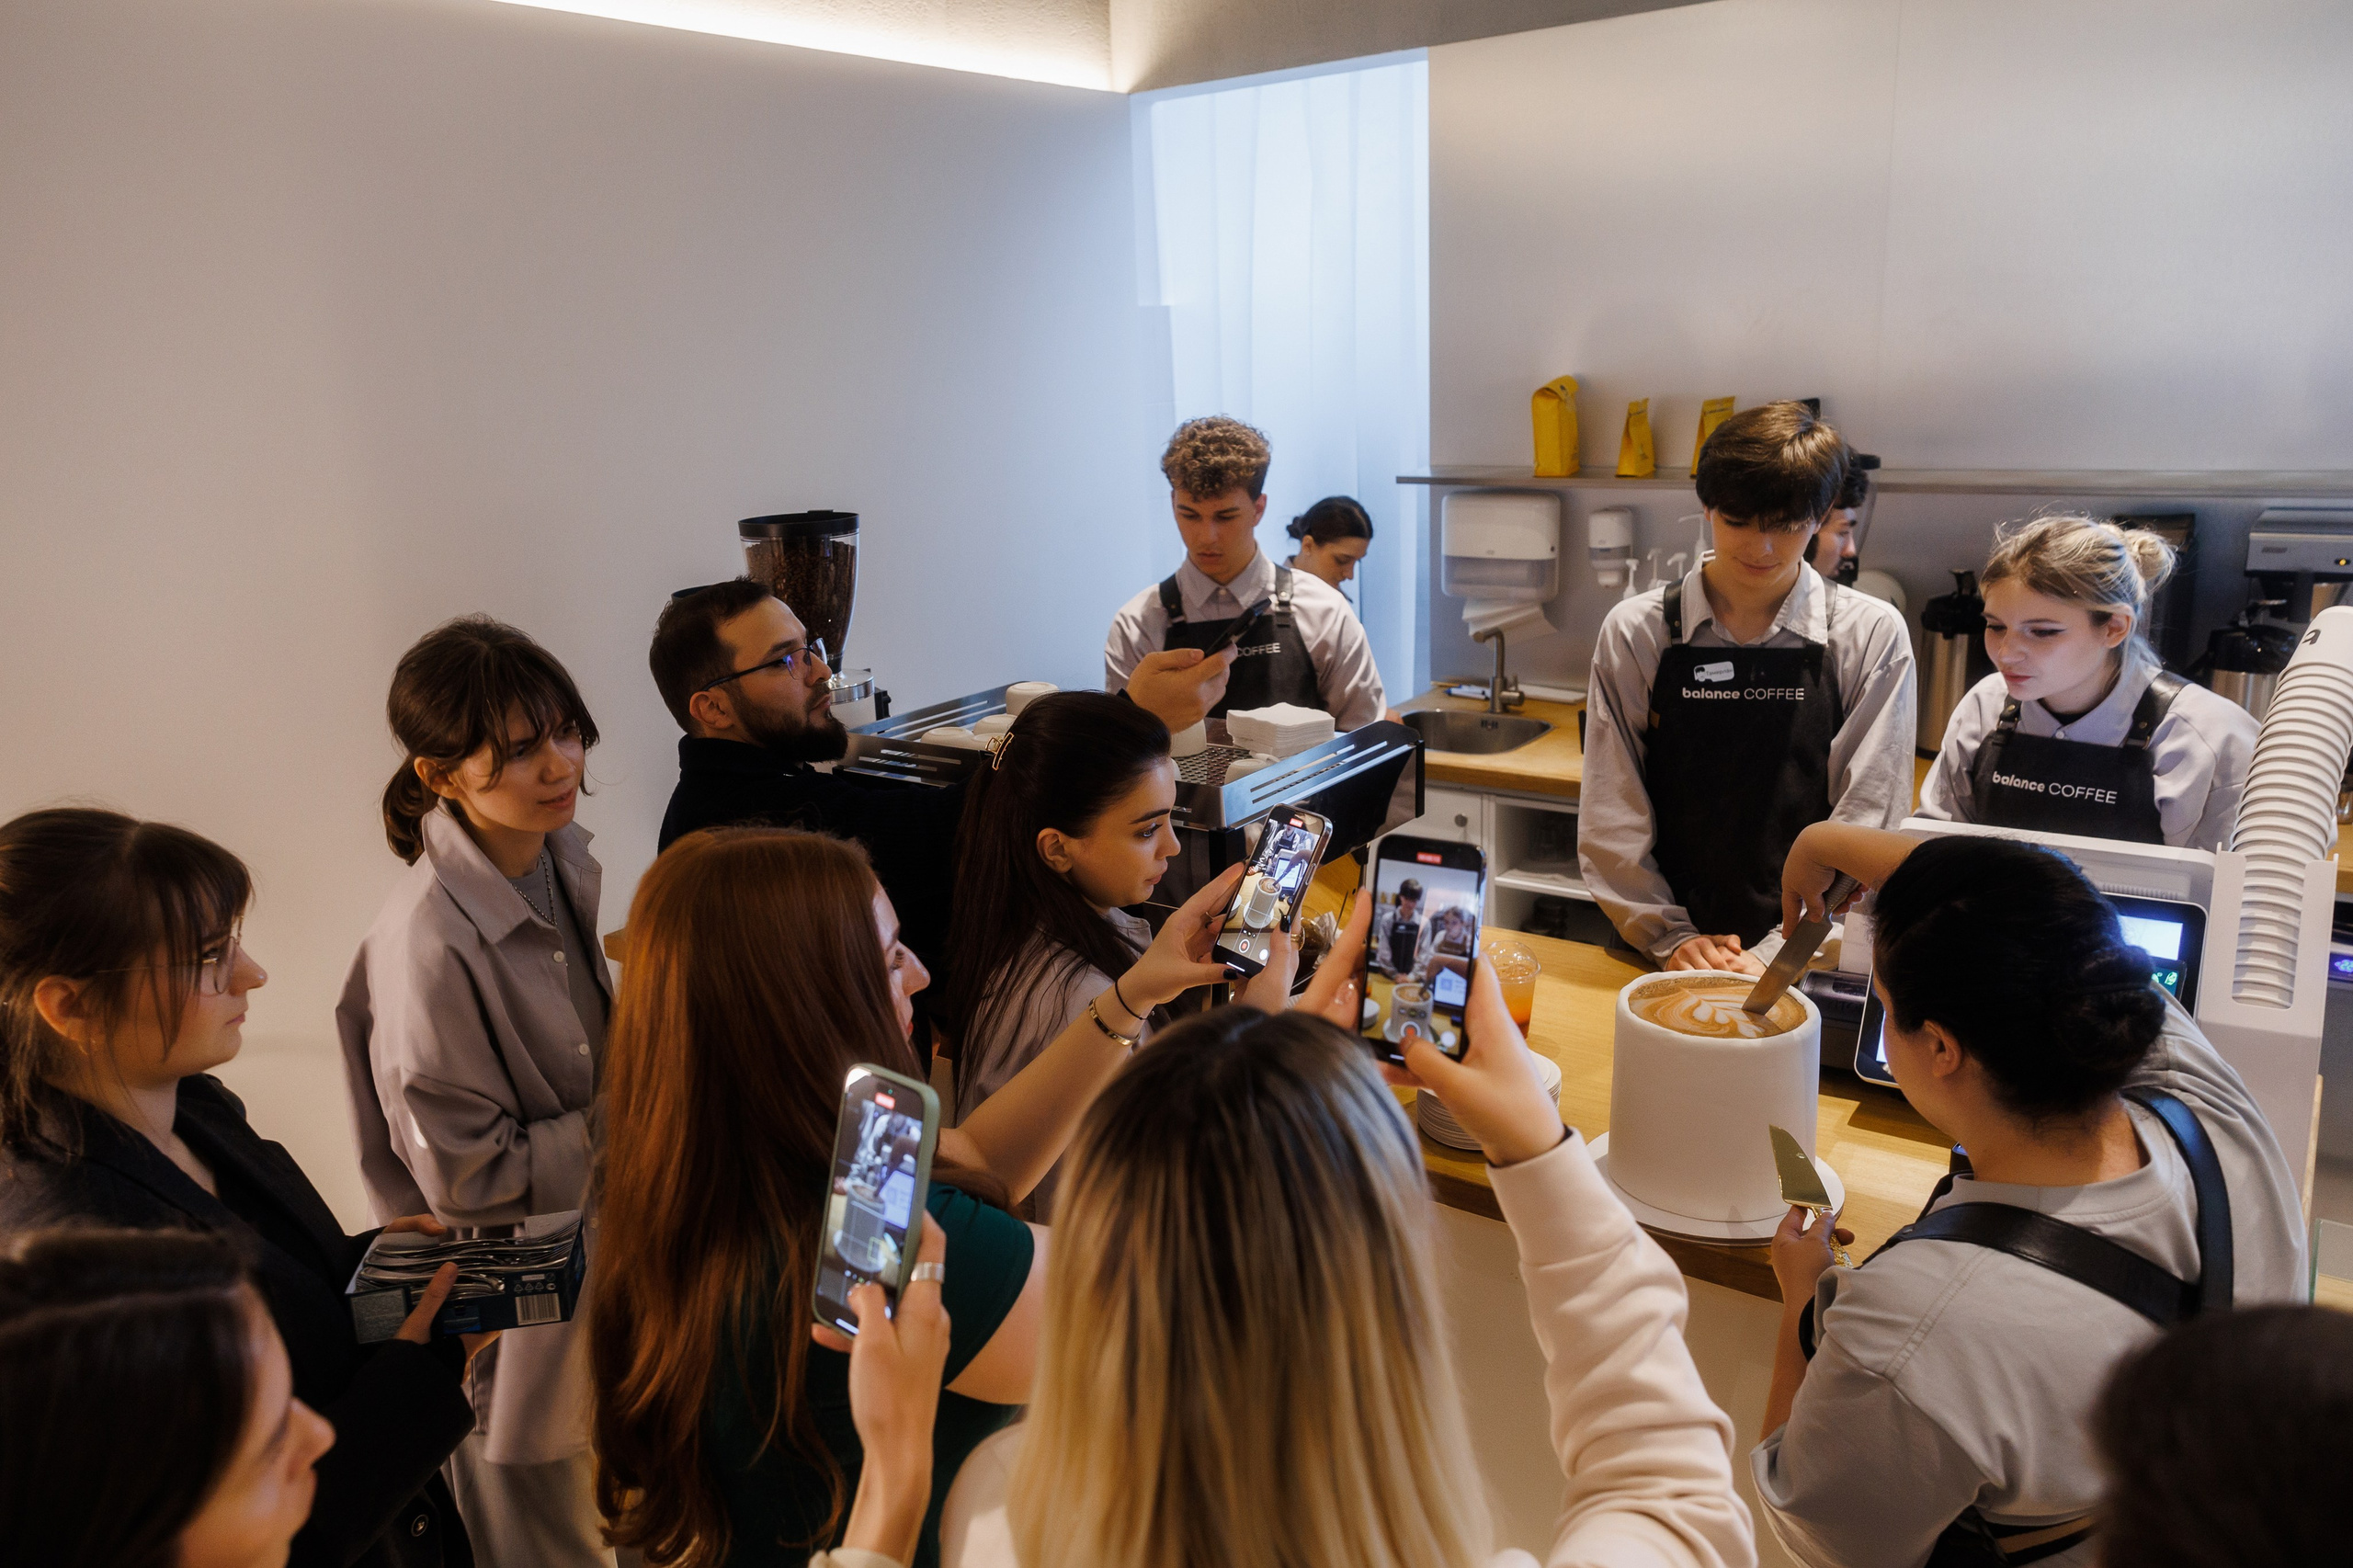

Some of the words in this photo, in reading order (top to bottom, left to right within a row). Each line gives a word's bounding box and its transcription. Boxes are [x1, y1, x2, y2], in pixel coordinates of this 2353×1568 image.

[1682, 687, 1741, 699] balance
[1744, 687, 1805, 700] COFFEE
[1992, 770, 2046, 793] balance
[2048, 782, 2119, 805] COFFEE
